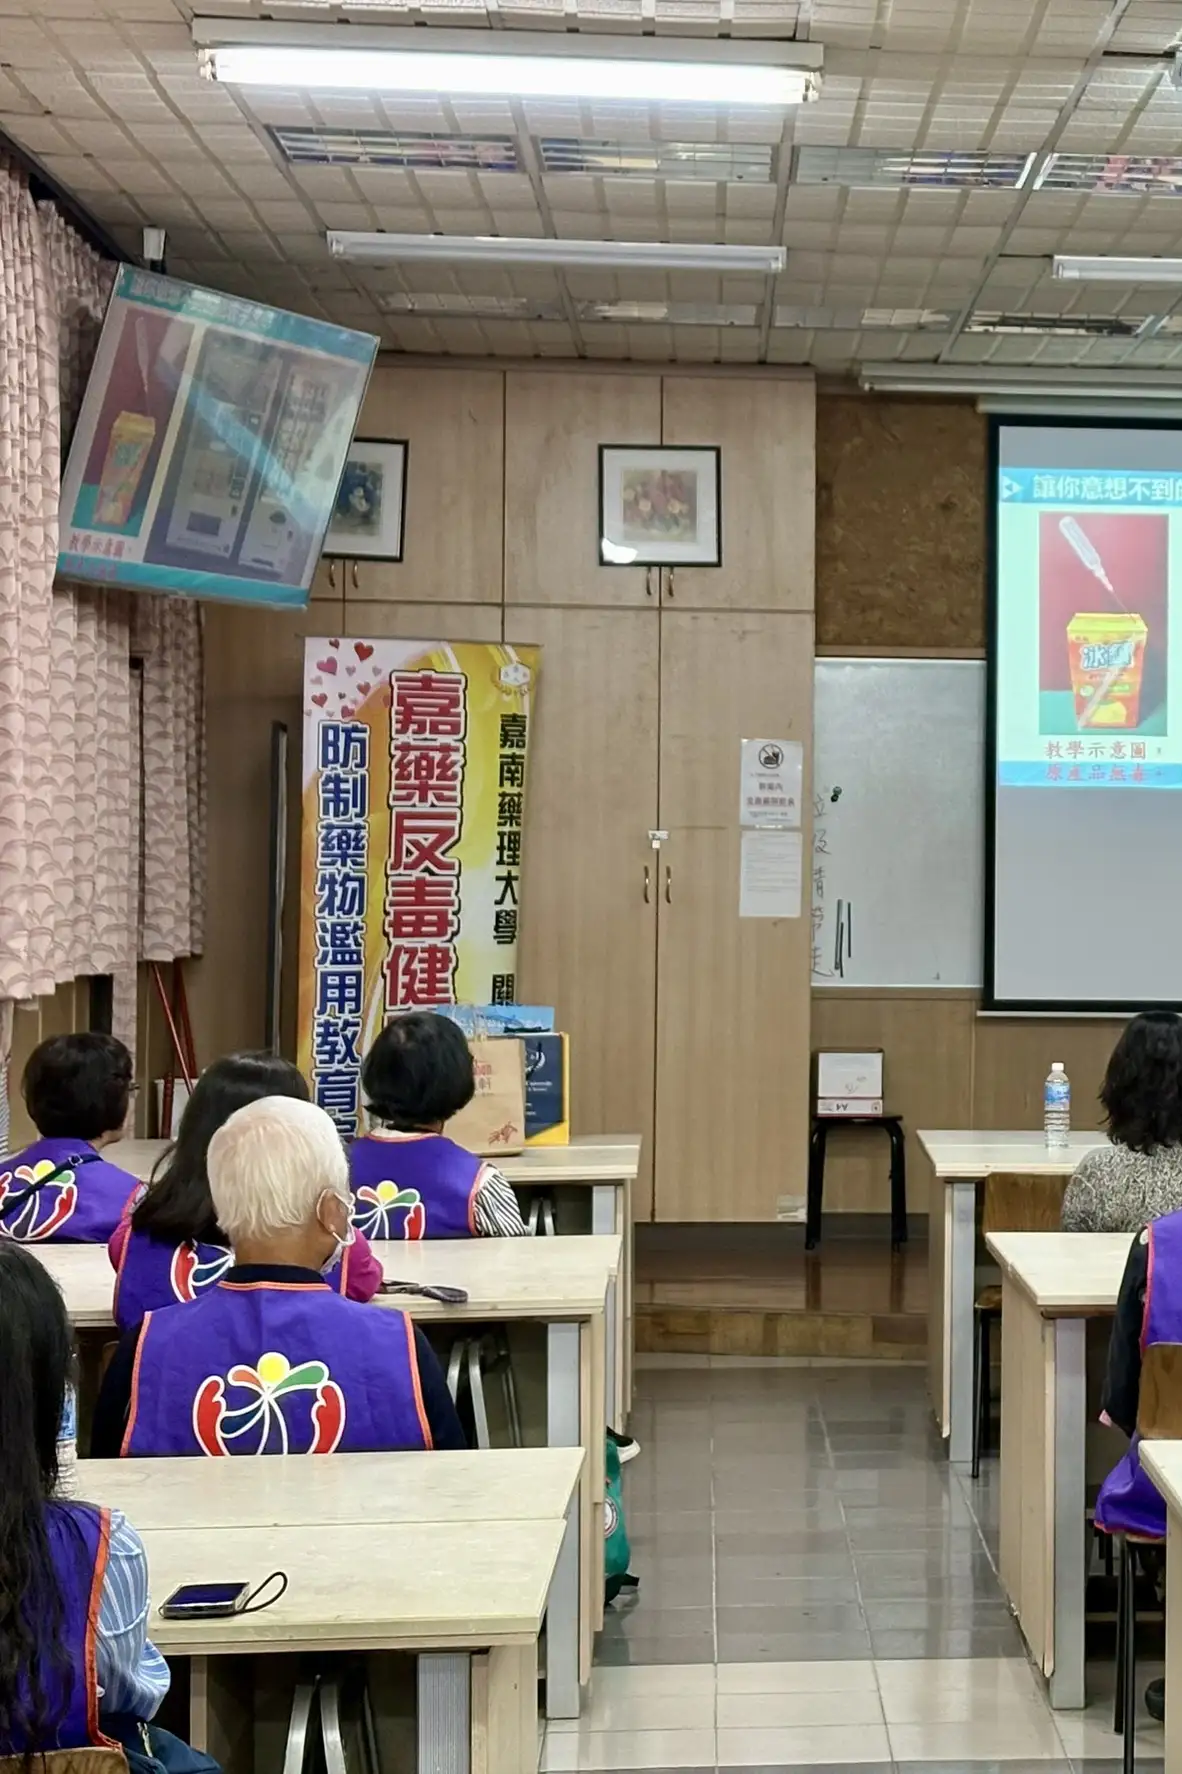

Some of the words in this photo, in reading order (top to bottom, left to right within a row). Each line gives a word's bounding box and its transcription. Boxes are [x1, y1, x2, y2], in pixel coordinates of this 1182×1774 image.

[384, 669, 468, 1012] 嘉藥反毒健
[493, 713, 528, 945] 嘉南藥理大學
